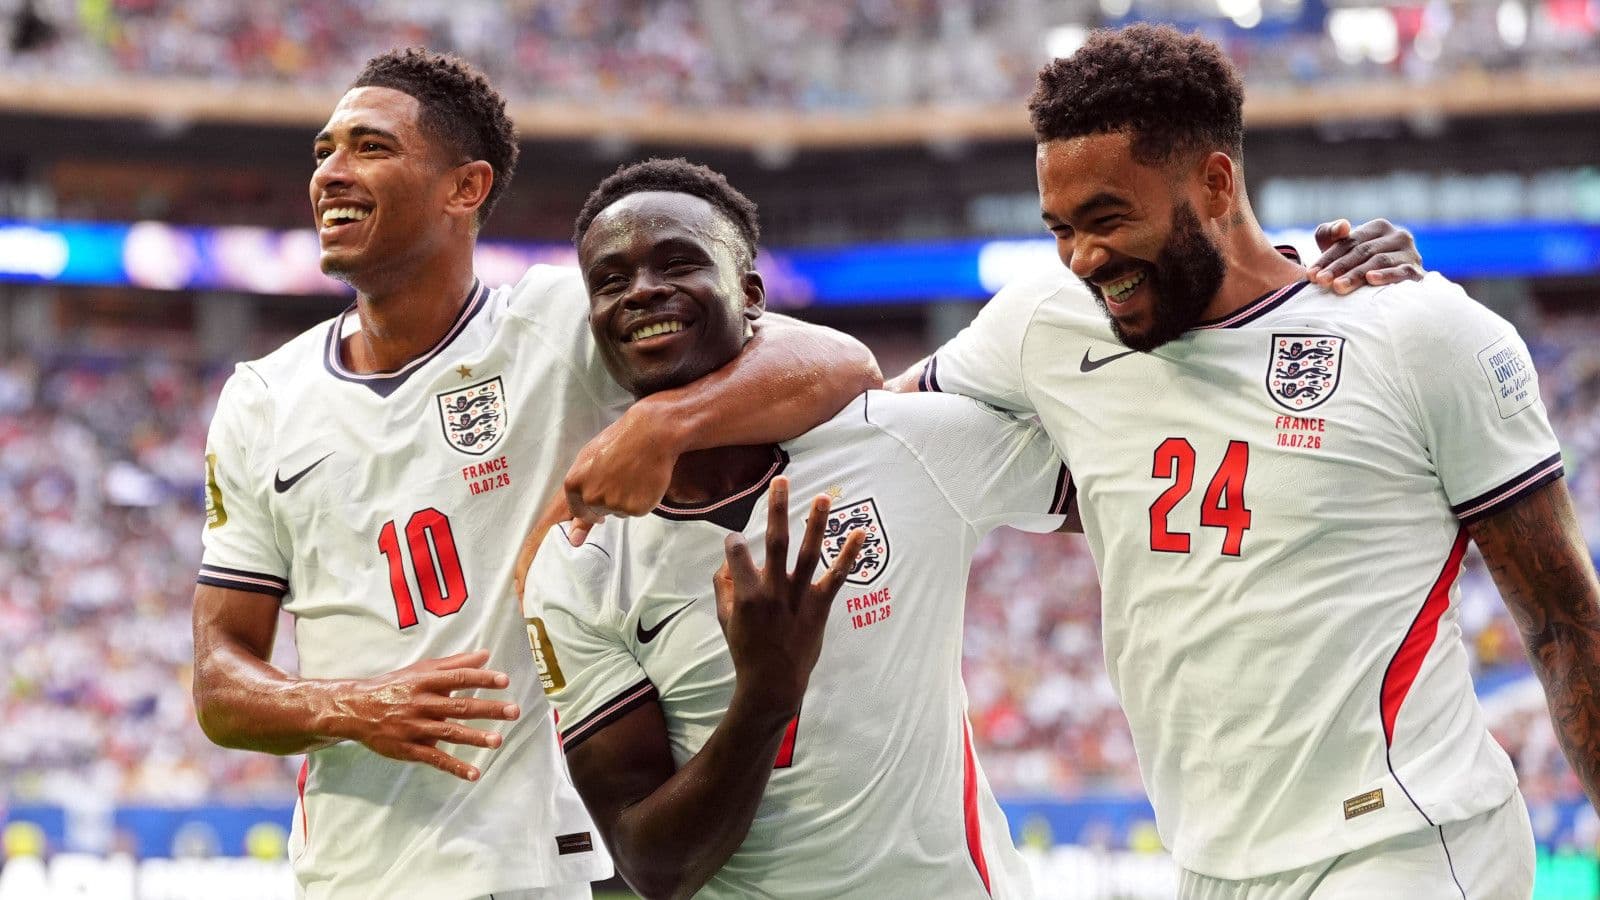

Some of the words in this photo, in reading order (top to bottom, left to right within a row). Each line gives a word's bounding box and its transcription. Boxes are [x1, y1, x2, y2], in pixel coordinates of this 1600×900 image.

[1488, 345, 1518, 369] FOOTBA
[1494, 354, 1526, 383] UNITES
[1500, 384, 1514, 399] the
[1275, 415, 1326, 432] FRANCE
[1277, 433, 1322, 449] 18.07.26
[462, 456, 508, 481] FRANCE
[469, 473, 510, 496] 18.07.26
[1149, 437, 1252, 557] 24
[377, 507, 469, 630] 10
[846, 587, 891, 613] FRANCE
